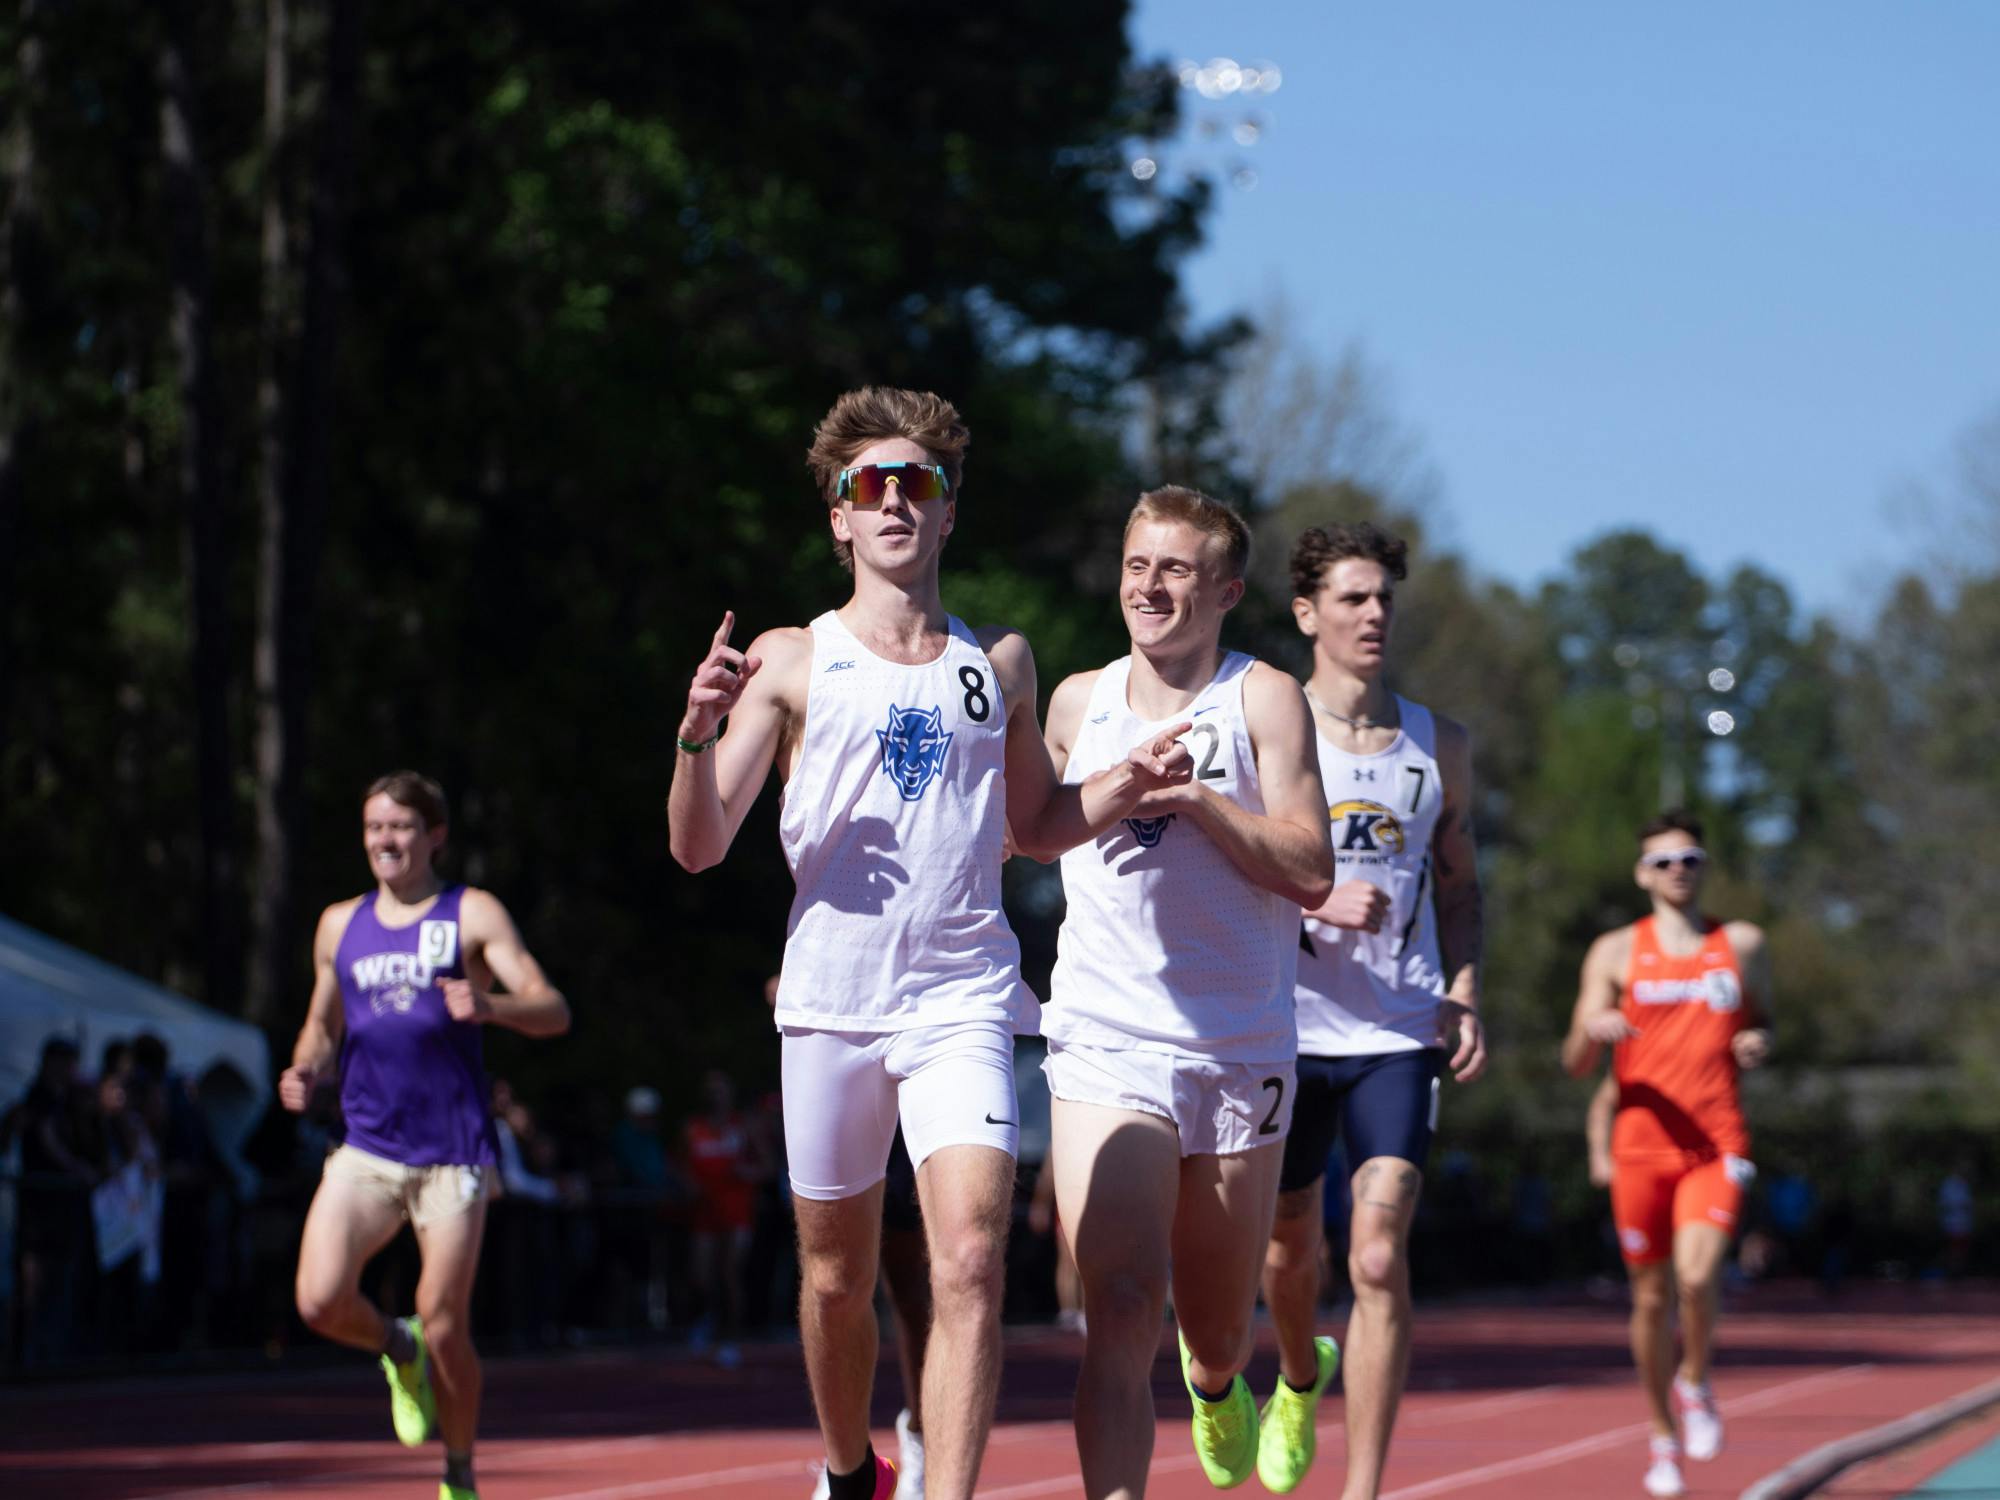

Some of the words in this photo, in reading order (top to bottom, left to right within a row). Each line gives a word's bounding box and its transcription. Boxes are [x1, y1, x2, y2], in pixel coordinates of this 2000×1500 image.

[824, 660, 856, 672] ACC
[958, 665, 989, 723] 8
[1192, 722, 1227, 780] 2
[1406, 766, 1425, 814] 7
[1341, 813, 1385, 851] K
[430, 923, 447, 958] 9
[352, 952, 433, 991] WCU
[1259, 1076, 1284, 1136] 2
